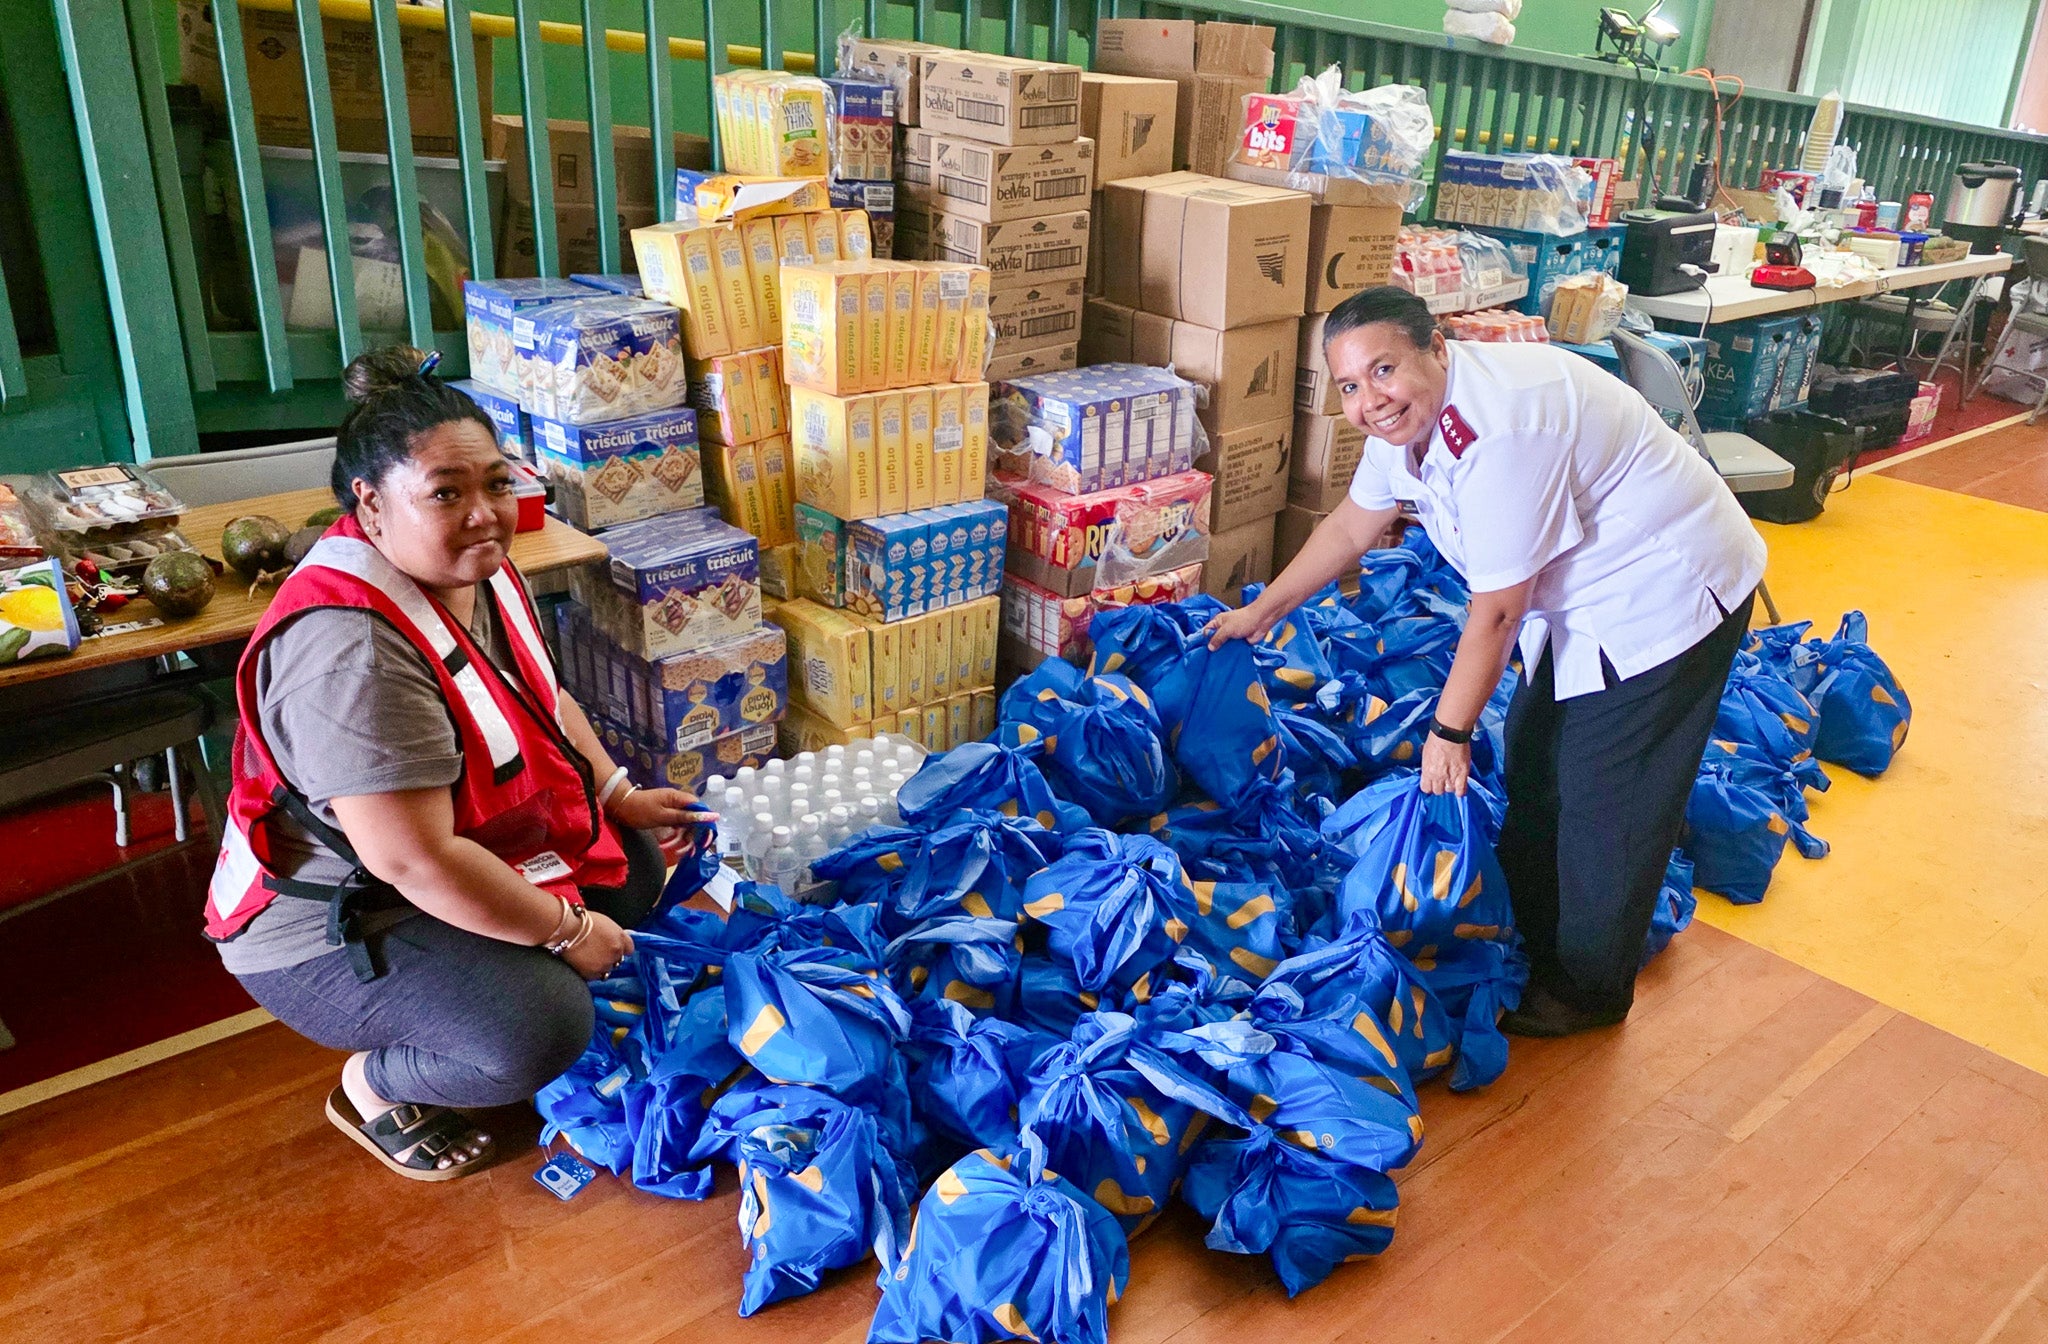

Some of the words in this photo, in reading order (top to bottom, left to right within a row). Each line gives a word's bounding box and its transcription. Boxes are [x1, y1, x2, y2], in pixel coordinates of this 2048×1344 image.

[782, 101, 811, 115] WHEAT
[925, 90, 953, 112] belVita
[784, 113, 813, 131] THINS
[1249, 127, 1286, 151] bits
[997, 179, 1031, 201] belVita
[987, 252, 1022, 271] belVita
[732, 279, 750, 330] original
[763, 274, 779, 324] original
[701, 285, 718, 336] original
[631, 317, 674, 337] triscuit
[923, 314, 931, 356] reduced
[585, 430, 636, 451] triscuit
[646, 419, 694, 440] triscuit
[915, 443, 926, 490] original
[943, 452, 956, 485] iginal
[969, 435, 979, 482] original
[857, 451, 869, 500] original
[888, 447, 898, 494] original
[747, 486, 760, 524] reduced
[706, 548, 754, 571] triscuit
[645, 562, 697, 585] triscuit
[743, 700, 774, 715] Honey
[747, 691, 771, 704] Maid
[669, 757, 700, 771] Honey
[672, 767, 696, 780] Maid
[522, 854, 555, 867] American
[528, 865, 543, 873] Red
[541, 860, 561, 869] Cross
